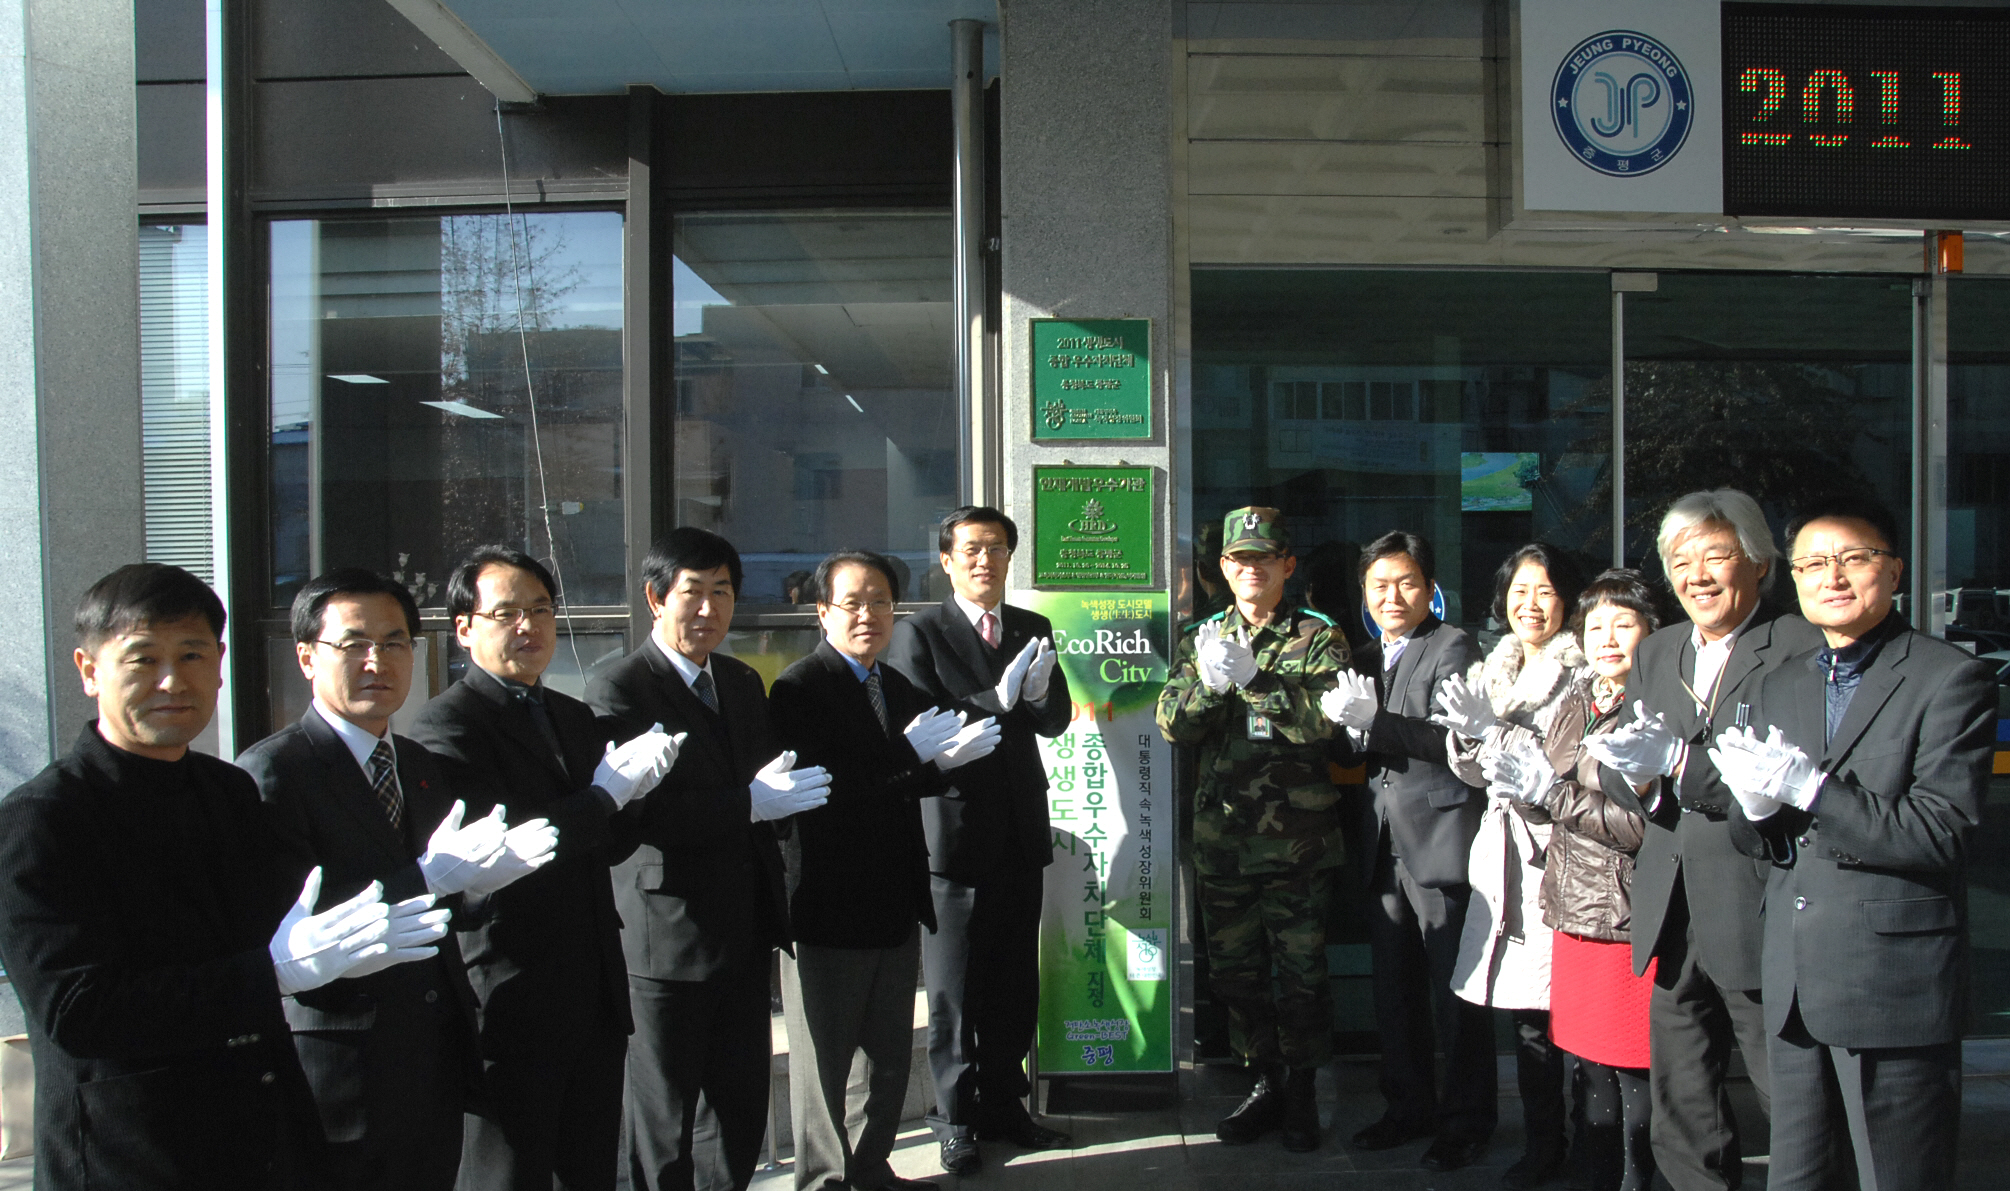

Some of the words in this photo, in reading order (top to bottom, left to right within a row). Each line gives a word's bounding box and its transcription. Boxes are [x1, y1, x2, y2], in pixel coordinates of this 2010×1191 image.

[1569, 38, 1614, 75] JEUNG
[1622, 37, 1678, 78] PYEONG
[1740, 67, 1972, 150] 2011
[1582, 145, 1664, 171] 증평군
[1056, 337, 1082, 350] 2011
[1079, 519, 1107, 532] HRD
[1081, 599, 1116, 610] 녹색성장
[1117, 599, 1153, 610] 도시모델
[1052, 629, 1152, 655] EcoRich
[1099, 658, 1153, 690] City
[1047, 732, 1078, 857] 생생도시
[1087, 972, 1106, 1009] 지정
[1066, 1031, 1128, 1041] Green-BEST
[1081, 1044, 1114, 1067] 증평
